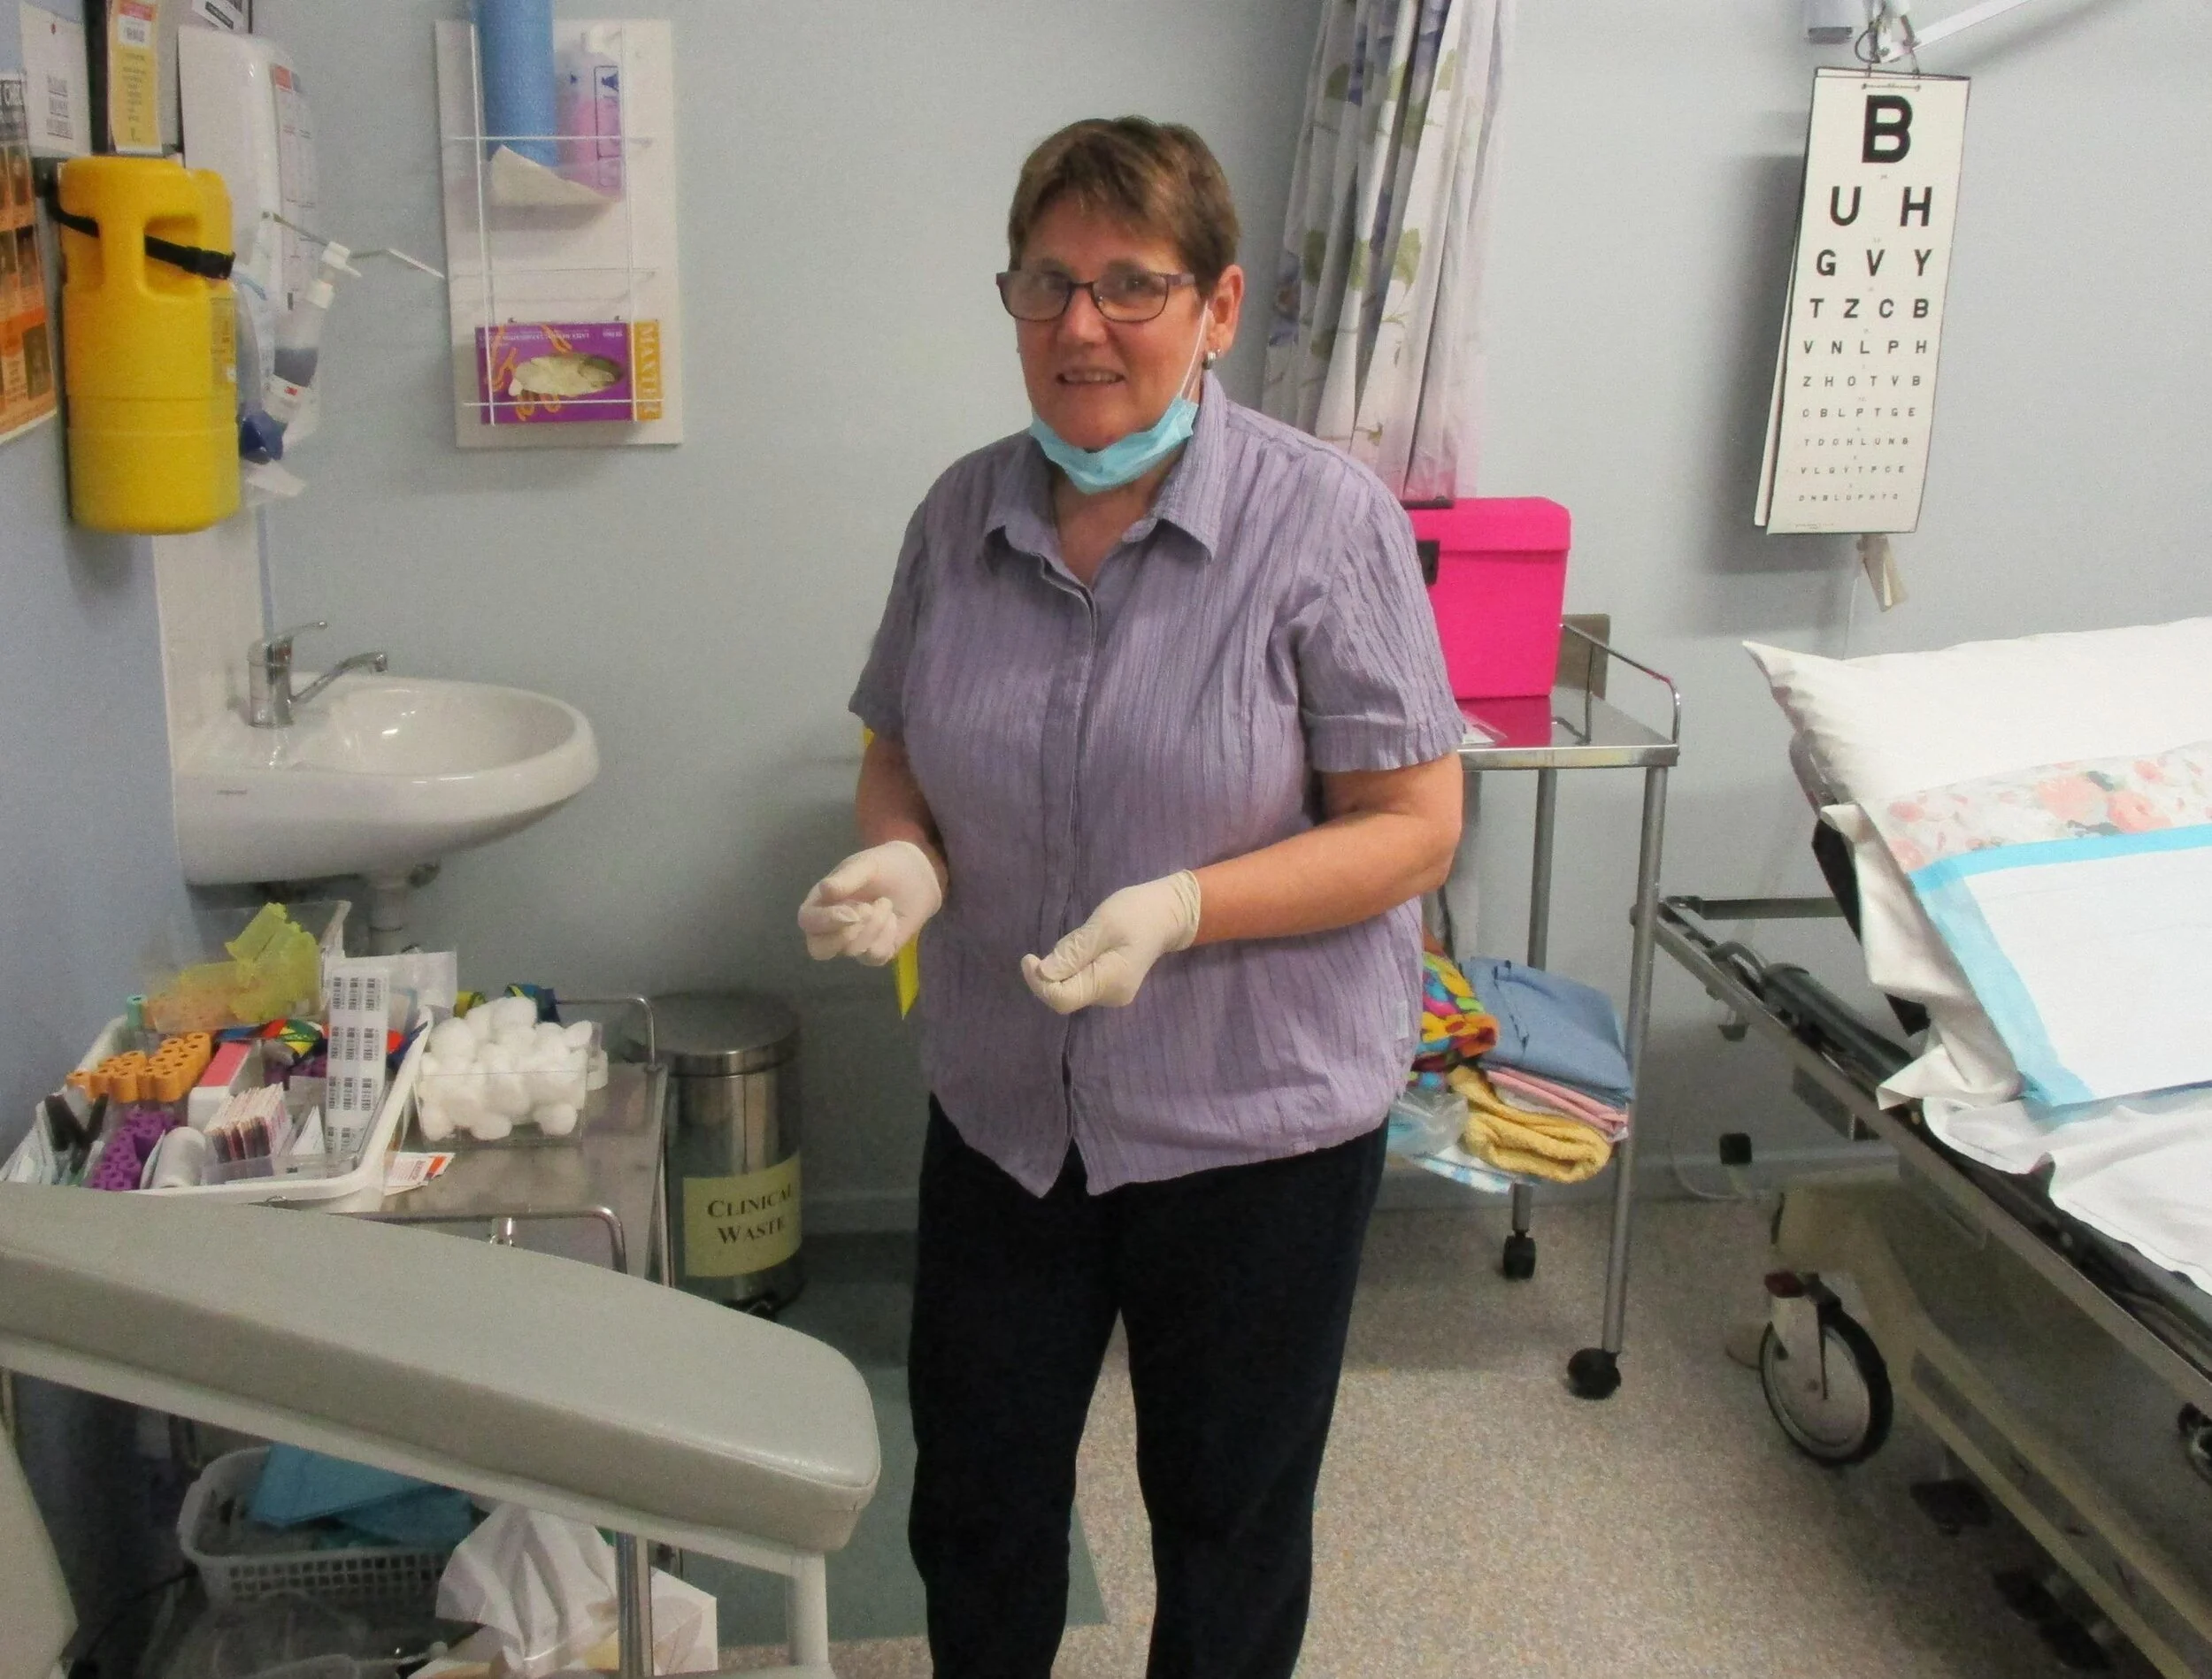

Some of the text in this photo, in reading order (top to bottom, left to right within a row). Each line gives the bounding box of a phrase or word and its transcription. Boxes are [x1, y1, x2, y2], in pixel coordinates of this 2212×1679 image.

[1862, 95, 1913, 164] B
[1830, 186, 1932, 226] U H
[1816, 249, 1932, 276] G V Y
[1809, 298, 1929, 318] T Z C B
[1803, 340, 1928, 355] V N L P H
[718, 1216, 786, 1245] WASTE
